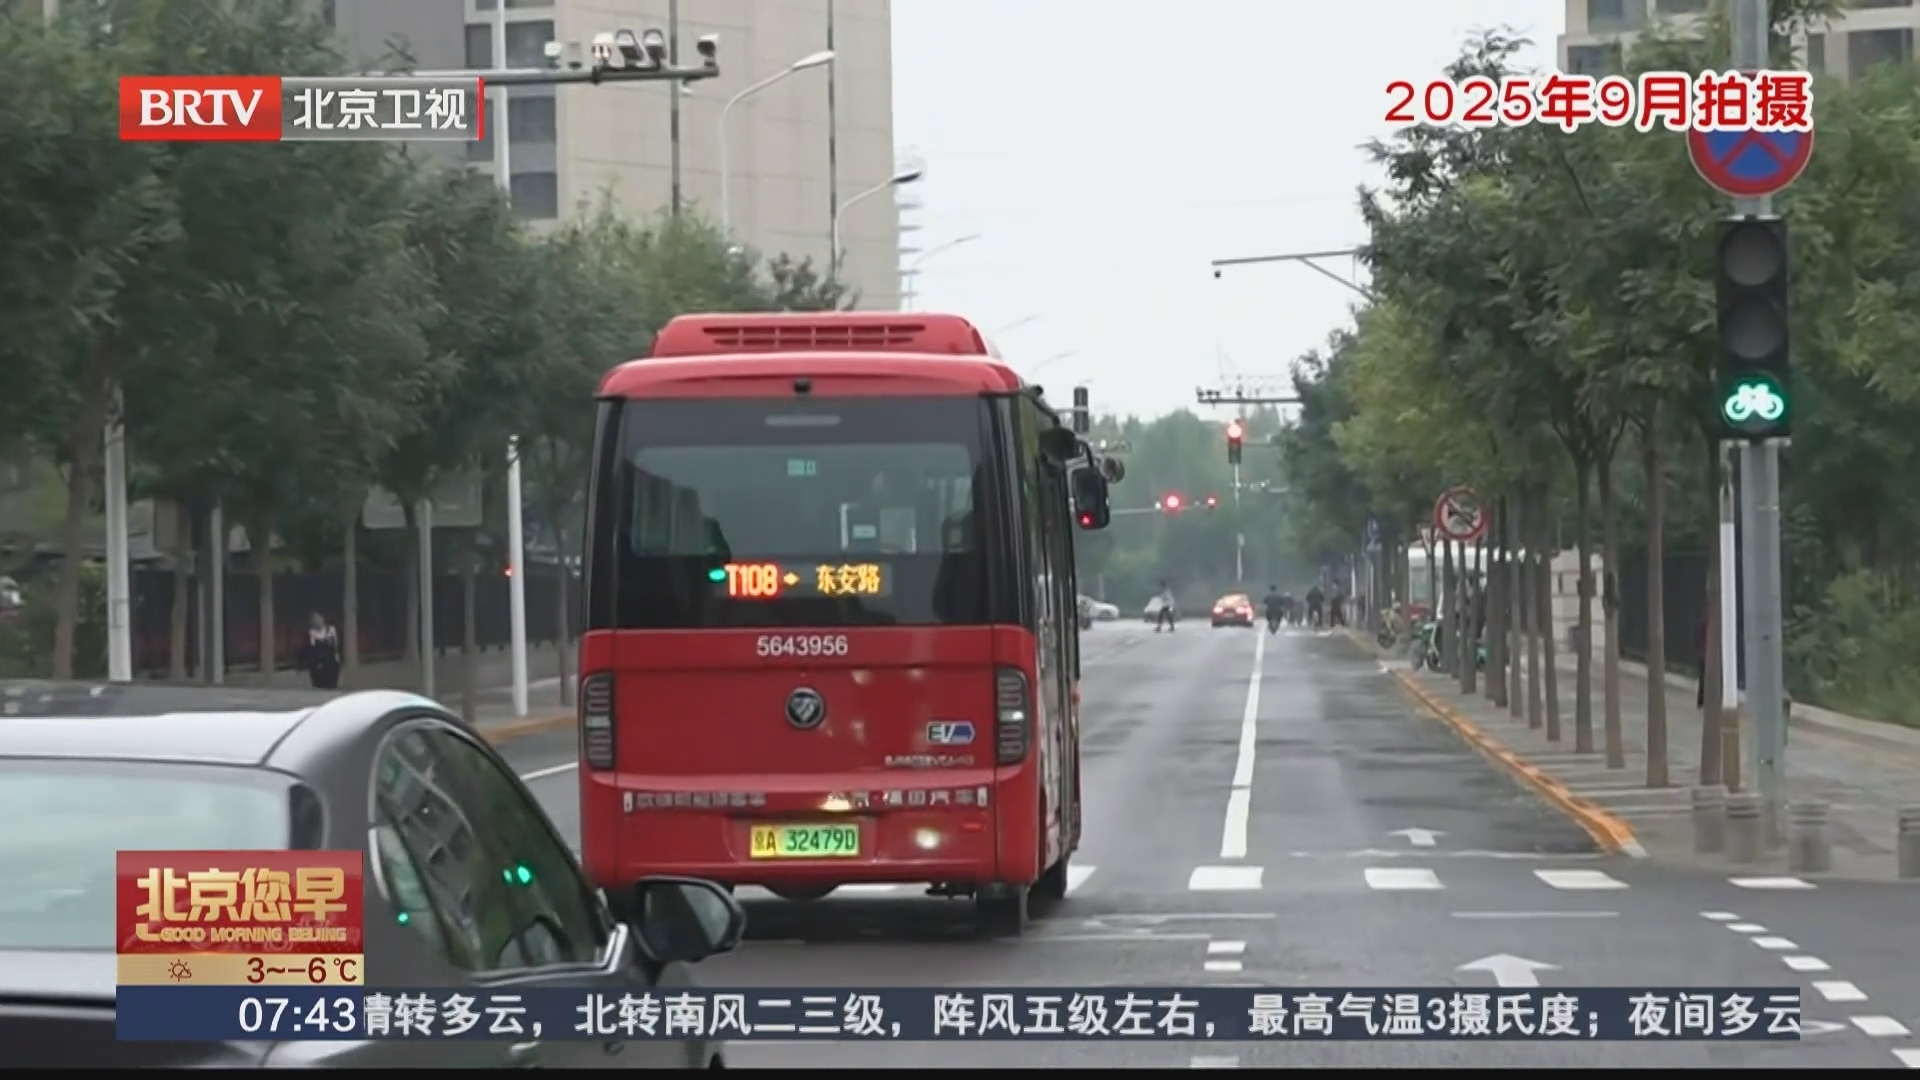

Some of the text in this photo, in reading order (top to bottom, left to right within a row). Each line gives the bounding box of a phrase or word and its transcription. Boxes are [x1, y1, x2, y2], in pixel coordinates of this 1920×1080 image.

[725, 563, 881, 595] T108 东安路
[756, 635, 849, 657] 5643956
[786, 829, 856, 852] 32479D
